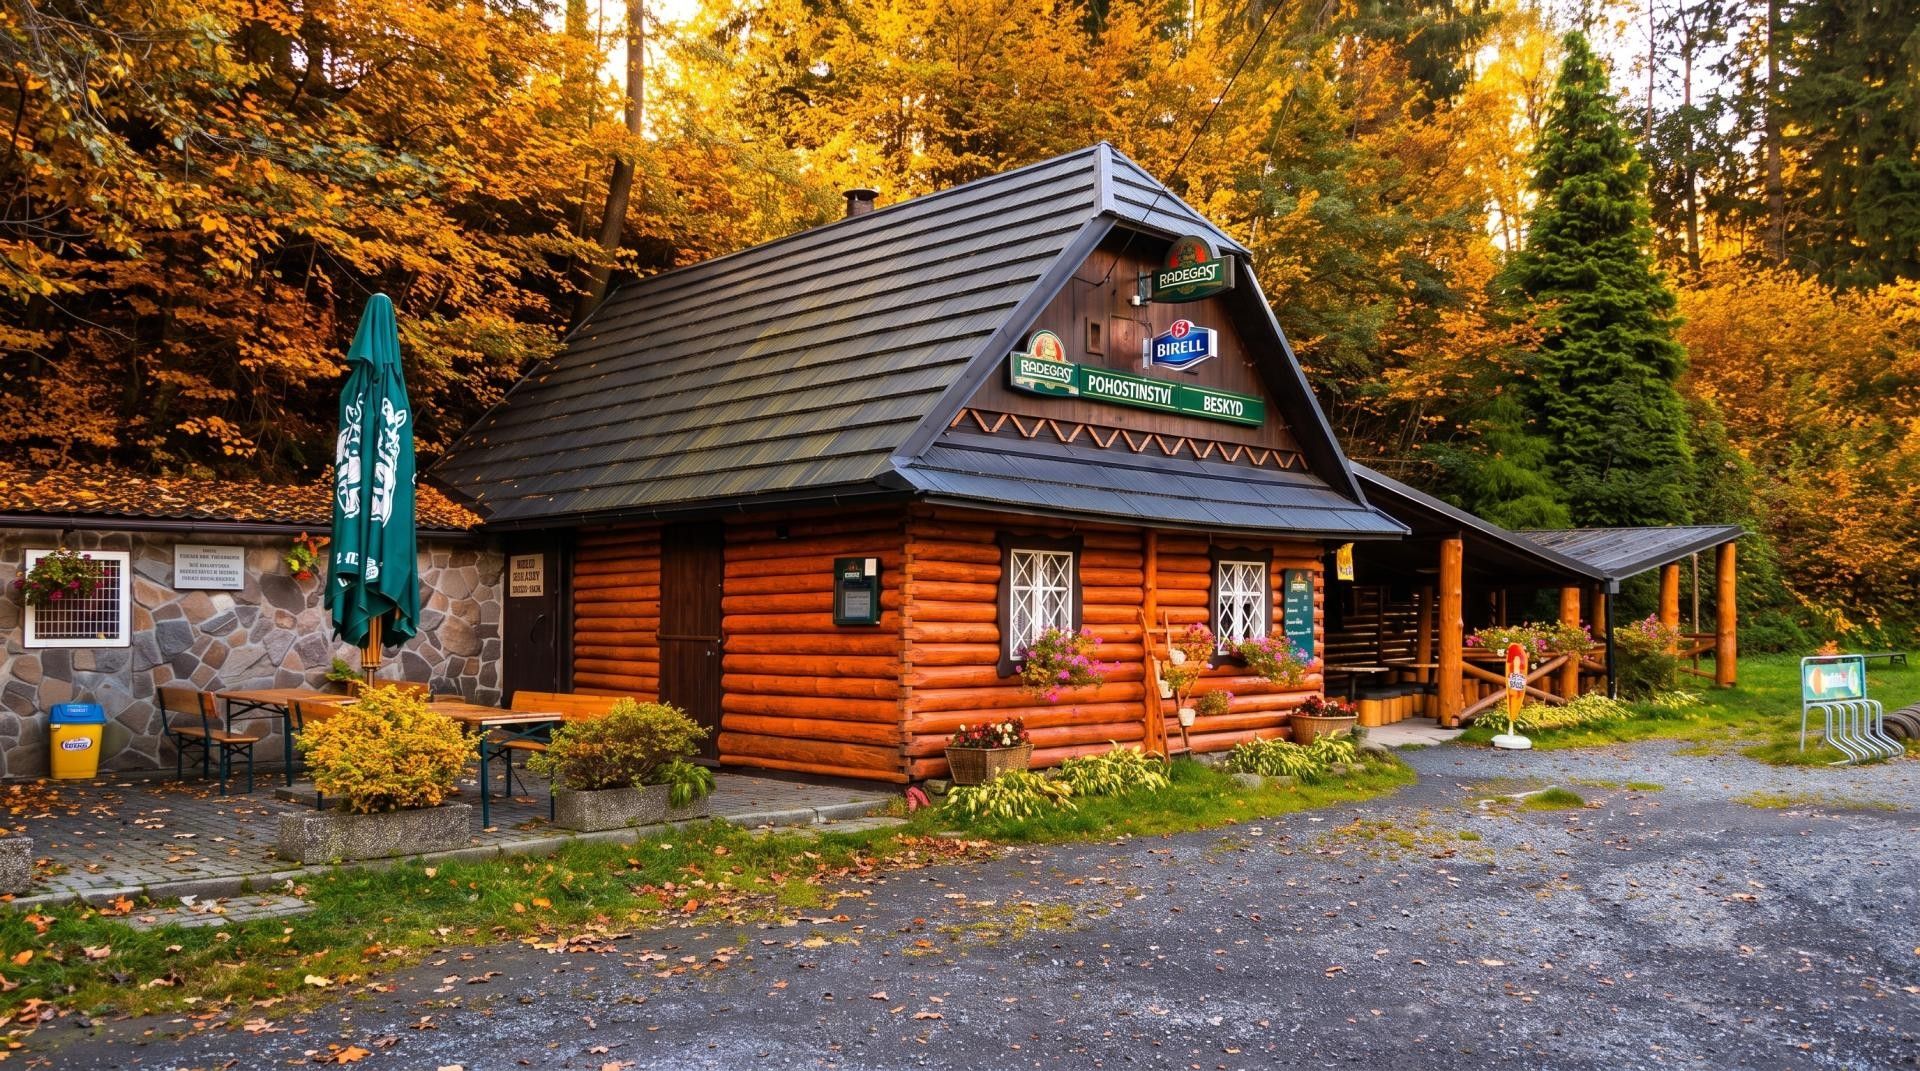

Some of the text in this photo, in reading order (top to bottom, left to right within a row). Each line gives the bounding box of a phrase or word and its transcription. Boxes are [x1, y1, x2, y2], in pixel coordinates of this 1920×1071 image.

[1159, 264, 1219, 288] RADEGAST
[1157, 340, 1205, 357] BIRELL
[1021, 360, 1073, 383] RADEGAST
[1088, 375, 1244, 416] POHOSTINSTVÍ BESKYD
